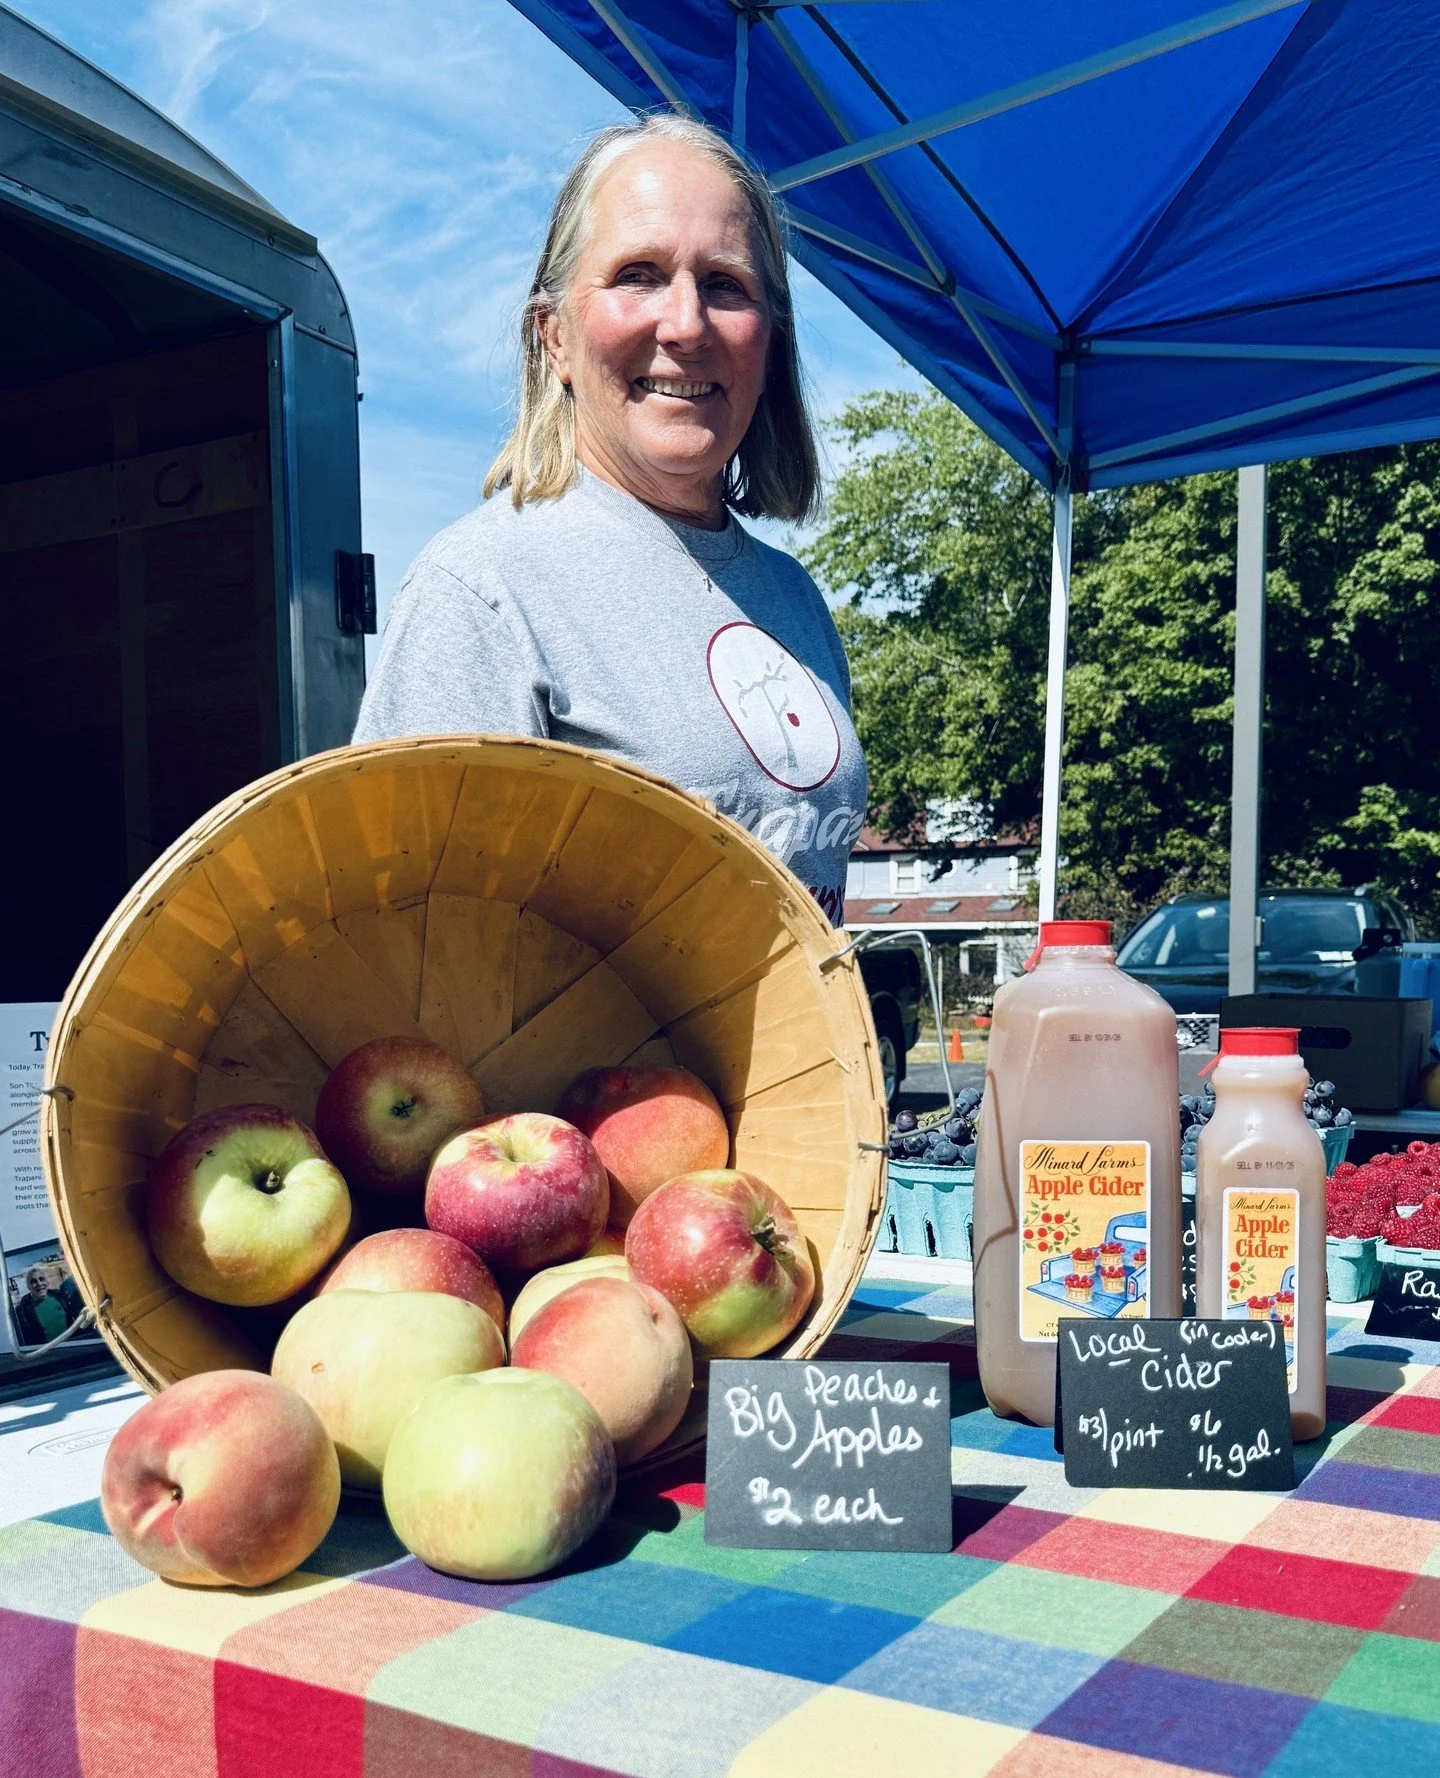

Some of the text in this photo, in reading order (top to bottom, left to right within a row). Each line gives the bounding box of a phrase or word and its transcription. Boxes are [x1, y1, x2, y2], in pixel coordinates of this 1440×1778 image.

[1024, 1144, 1090, 1175] Minard
[1236, 1161, 1251, 1170] SELL
[1254, 1161, 1263, 1170] BY
[1025, 1174, 1145, 1201] Apple Cider
[1230, 1196, 1265, 1213] Minard
[1234, 1213, 1290, 1239] Apple
[1235, 1238, 1289, 1259] Cider
[1068, 1323, 1162, 1362] Local
[1141, 1352, 1233, 1392] Cider
[724, 1384, 798, 1451] Big
[803, 1364, 919, 1407] Peaches
[791, 1406, 924, 1470] Apples
[748, 1476, 905, 1526] $2 each
